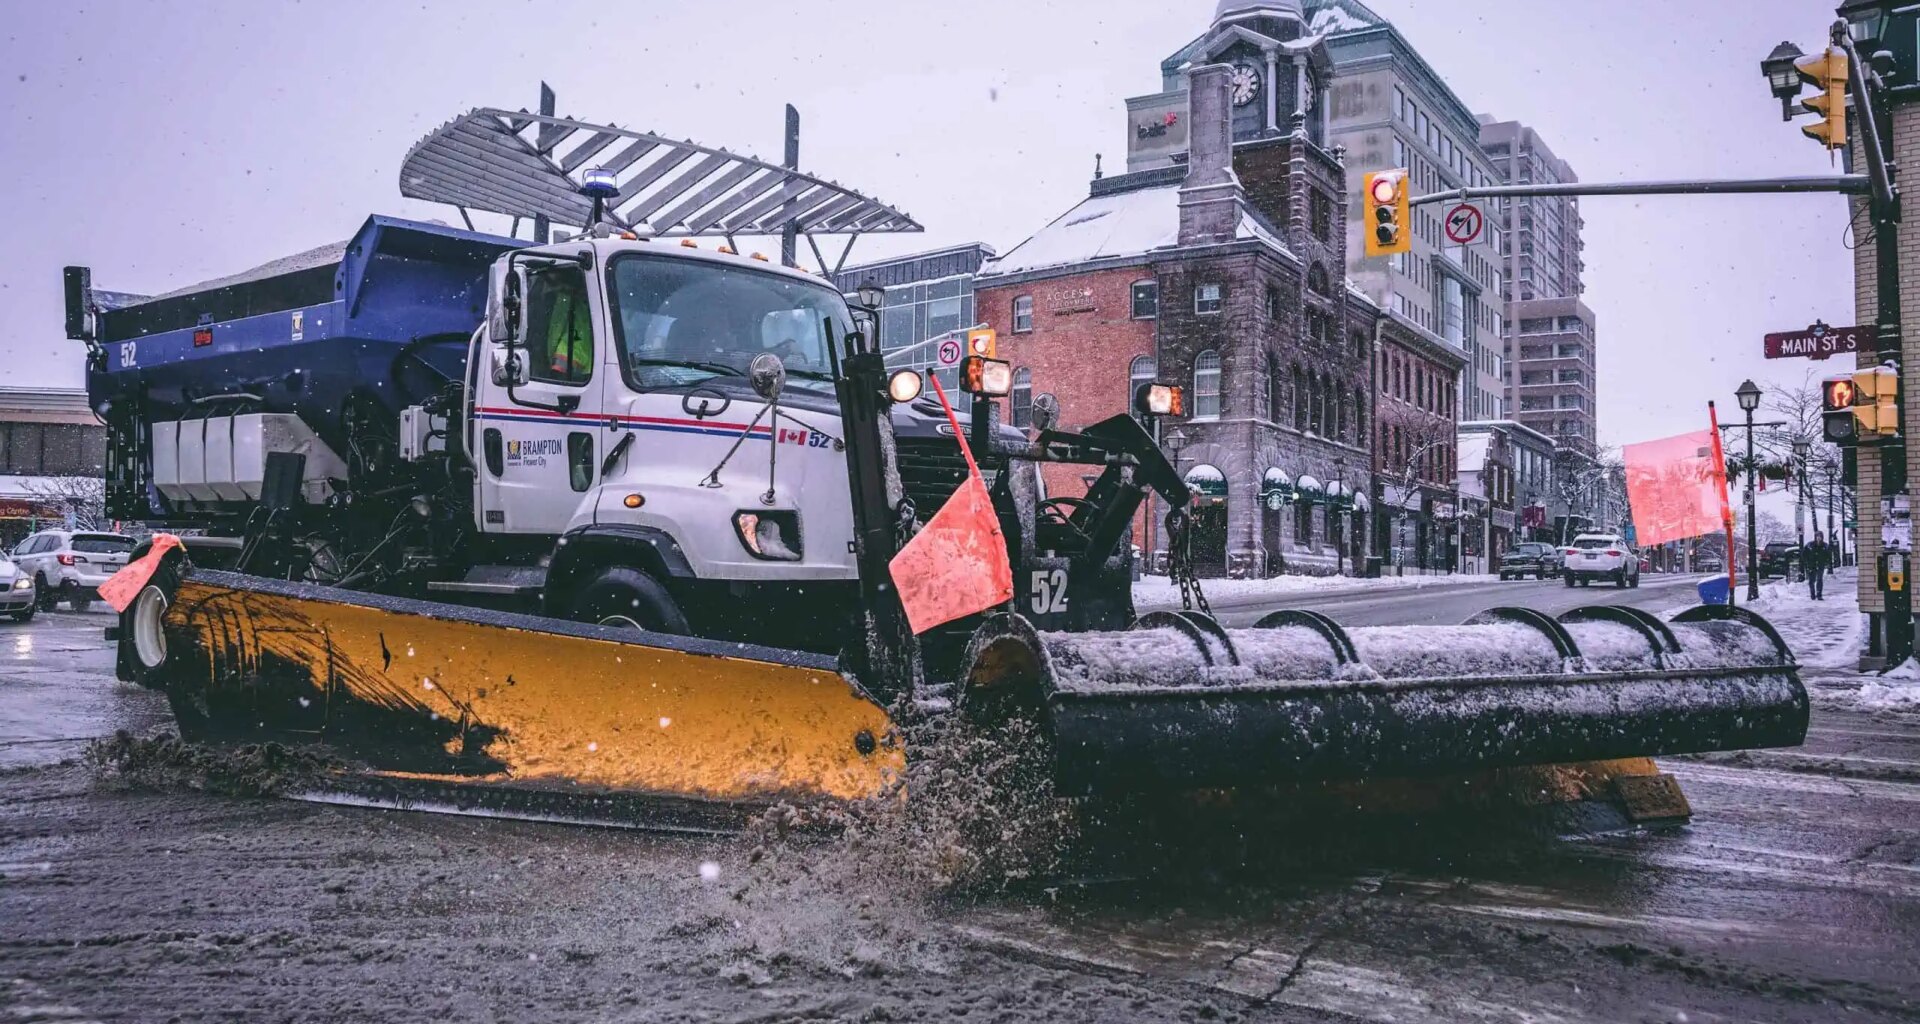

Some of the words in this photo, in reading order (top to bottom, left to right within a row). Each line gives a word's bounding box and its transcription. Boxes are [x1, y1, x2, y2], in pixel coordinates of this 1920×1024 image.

[120, 341, 137, 367] 52
[1781, 337, 1817, 355] MAIN
[1822, 334, 1840, 351] ST
[1846, 334, 1857, 350] S
[522, 439, 562, 456] BRAMPTON
[808, 431, 830, 449] 52
[1031, 569, 1068, 615] 52
